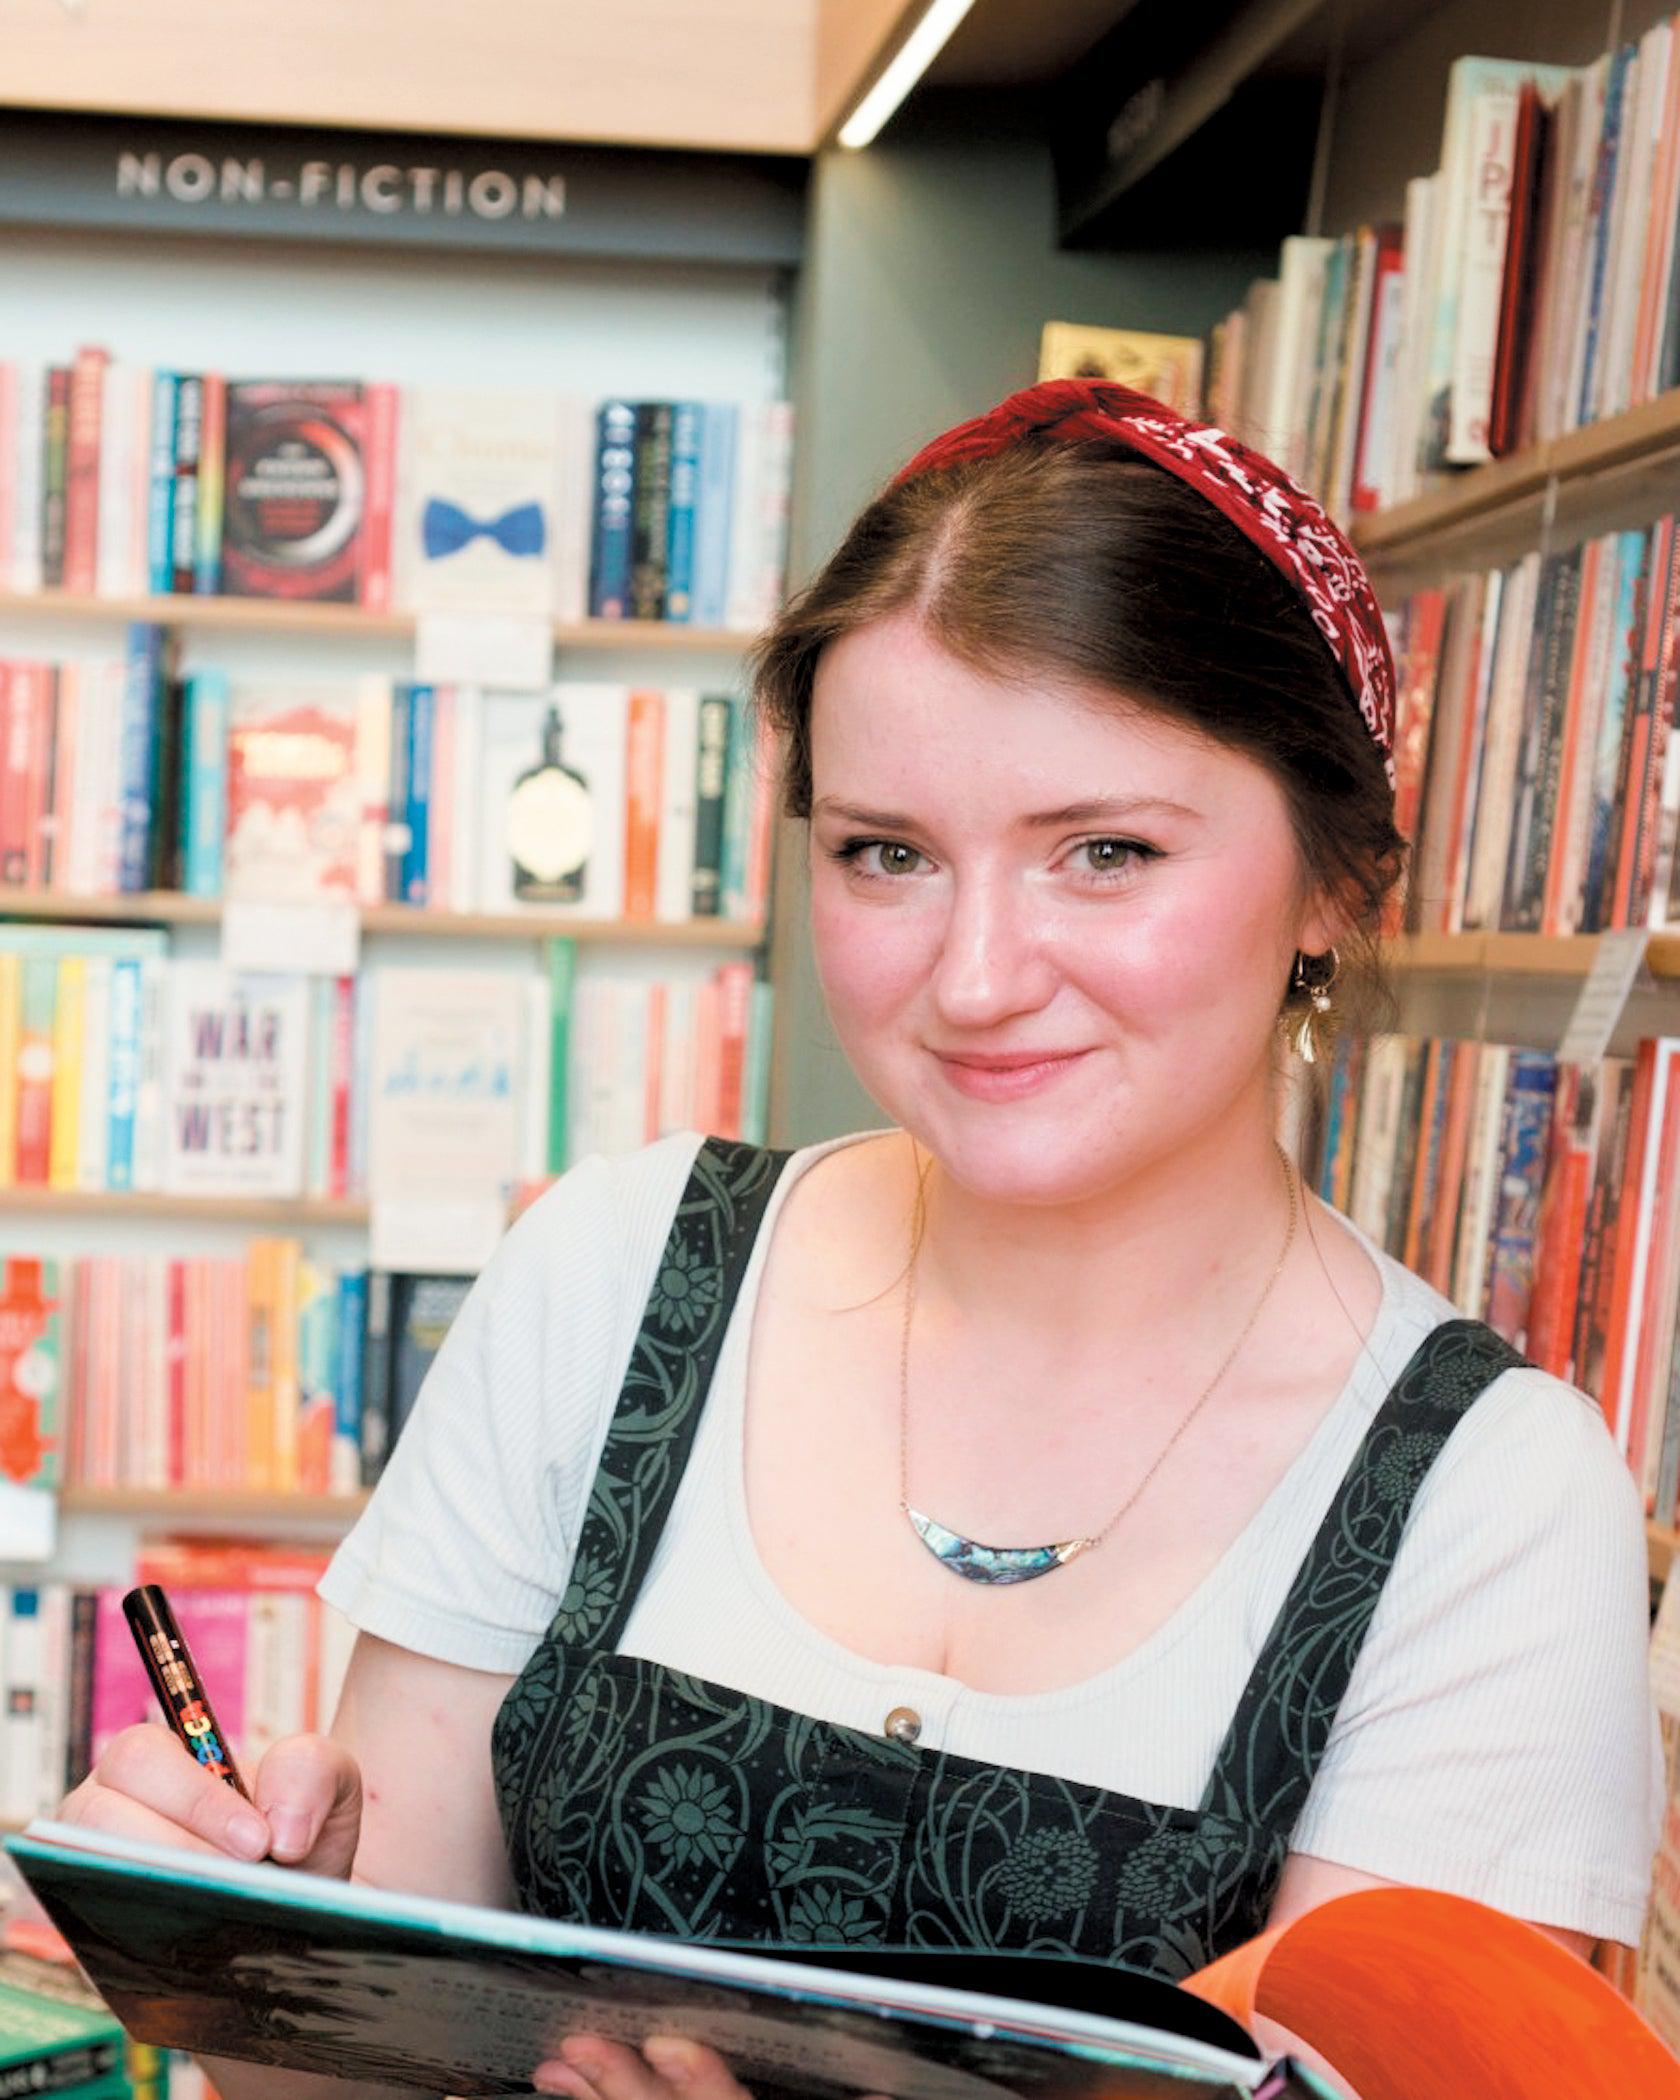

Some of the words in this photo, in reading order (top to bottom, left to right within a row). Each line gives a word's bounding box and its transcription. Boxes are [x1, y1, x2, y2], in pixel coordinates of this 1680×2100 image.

[116, 151, 567, 220] NON-FICTION
[189, 1008, 281, 1061] WAR
[174, 1101, 286, 1156] WEST
